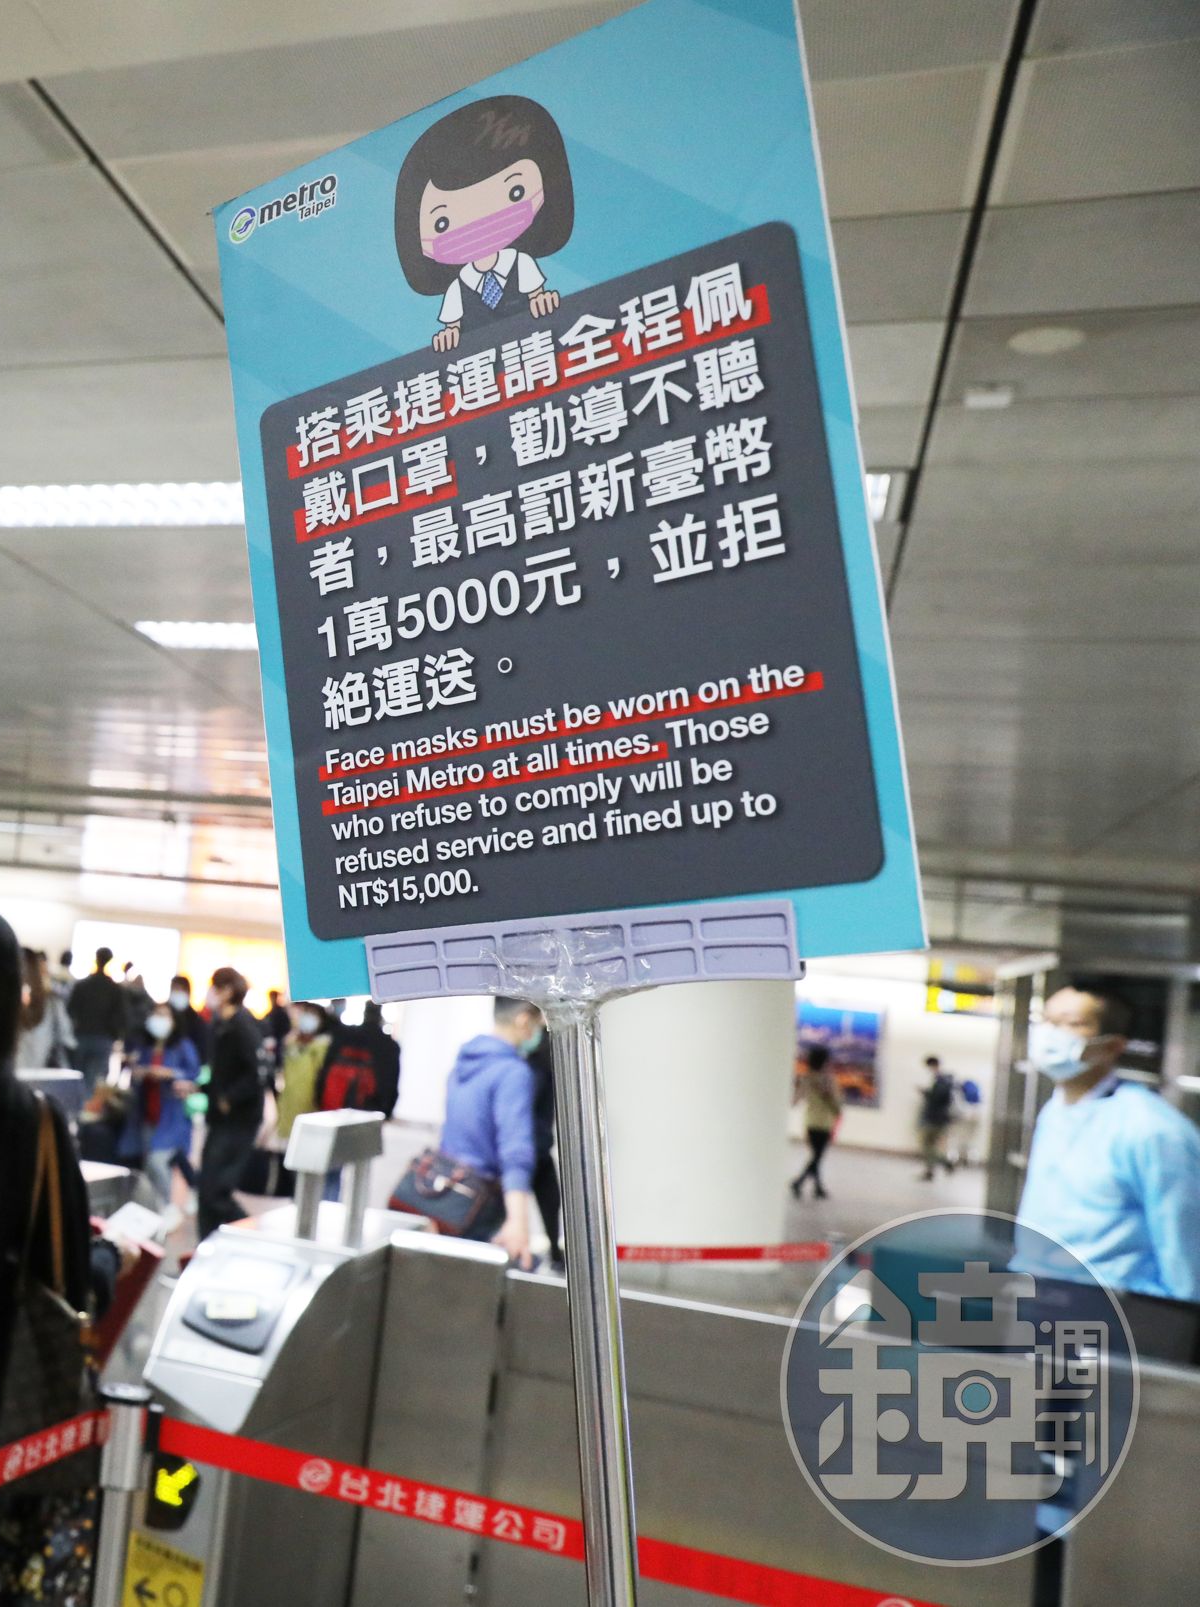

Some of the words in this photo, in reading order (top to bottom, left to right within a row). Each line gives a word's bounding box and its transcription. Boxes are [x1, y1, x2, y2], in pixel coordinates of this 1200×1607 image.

[259, 174, 337, 225] metro
[299, 193, 336, 220] Taipei
[296, 262, 752, 468] 搭乘捷運請全程佩
[302, 338, 765, 533] 戴口罩，勸導不聽
[317, 494, 785, 658] 1萬5000元，並拒
[326, 745, 385, 773] Face
[391, 726, 478, 761] masks
[485, 708, 557, 744] must
[563, 702, 601, 729] be
[608, 686, 689, 720] worn
[698, 676, 740, 703] on
[748, 664, 805, 694] the
[328, 774, 400, 807] Taipei
[406, 763, 484, 794] Metro
[492, 752, 520, 779] at
[527, 743, 558, 777] all
[565, 733, 659, 766] times.
[665, 712, 770, 748] Those
[331, 815, 384, 841] who
[391, 804, 472, 832] refuse
[478, 794, 507, 817] to
[515, 773, 622, 813] comply
[629, 761, 682, 794] will
[690, 757, 733, 785] be
[335, 838, 429, 875] refused
[435, 827, 534, 861] service
[542, 814, 597, 846] and
[603, 800, 682, 837] fined
[690, 799, 733, 829] up
[740, 791, 777, 818] to
[338, 868, 480, 909] NT$15,000.
[339, 1470, 566, 1551] 台北捷運公司
